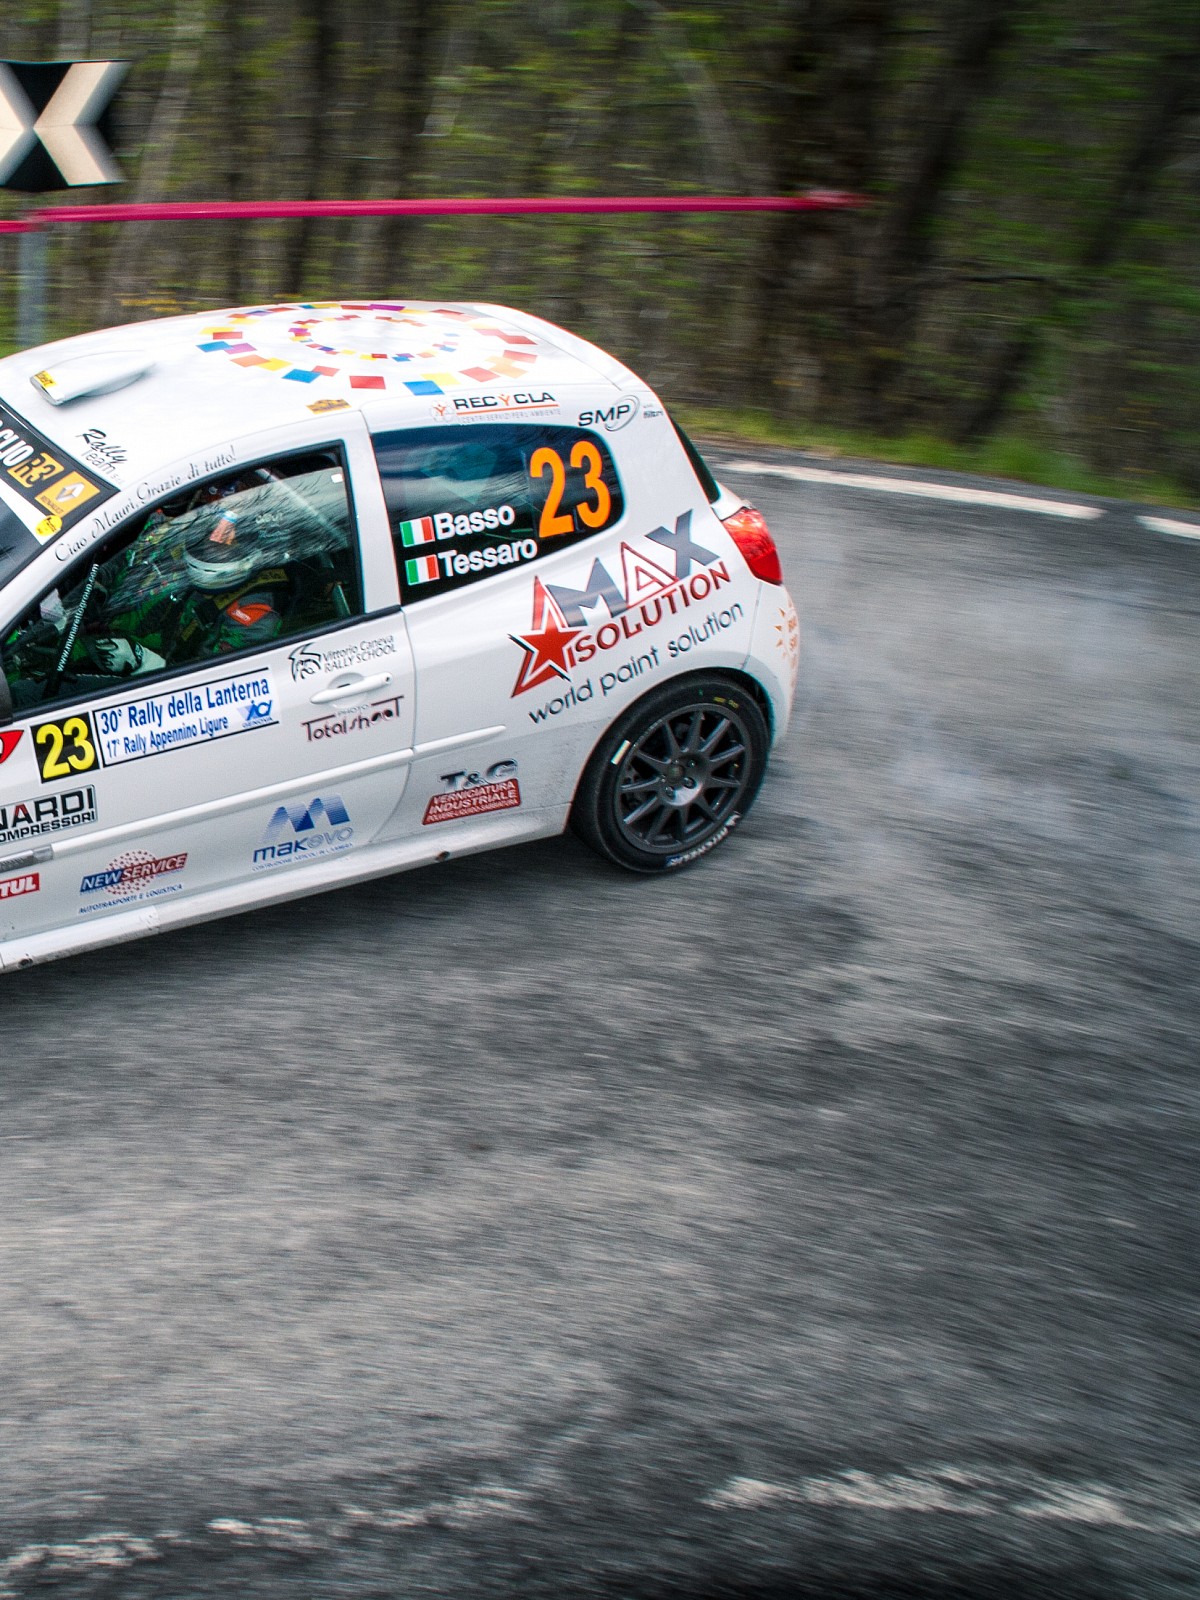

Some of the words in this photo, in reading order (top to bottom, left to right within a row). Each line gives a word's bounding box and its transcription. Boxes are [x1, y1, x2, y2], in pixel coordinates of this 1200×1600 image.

[453, 392, 556, 410] RECYCLA
[578, 404, 630, 427] SMP
[75, 428, 127, 464] Rally
[81, 449, 116, 474] Team
[11, 453, 58, 487] R3
[55, 537, 87, 562] Ciao
[137, 475, 181, 505] Grazie
[188, 463, 200, 480] di
[205, 445, 237, 472] tutto!
[529, 440, 611, 538] 23
[434, 505, 516, 540] Basso
[438, 537, 538, 577] Tessaro
[325, 655, 354, 672] RALLY
[357, 644, 397, 663] SCHOOL
[360, 636, 394, 652] Caneva
[529, 679, 593, 724] world
[600, 646, 660, 697] paint
[668, 602, 744, 658] solution
[128, 701, 163, 728] Rally
[168, 691, 203, 718] della
[206, 678, 270, 708] Lanterna
[37, 717, 95, 778] 23
[124, 734, 147, 755] Rally
[150, 723, 198, 751] Appennino
[199, 716, 229, 738] Ligure
[428, 789, 518, 814] INDUSTRIALE
[81, 871, 122, 890] NEW
[122, 855, 187, 881] SERVICE
